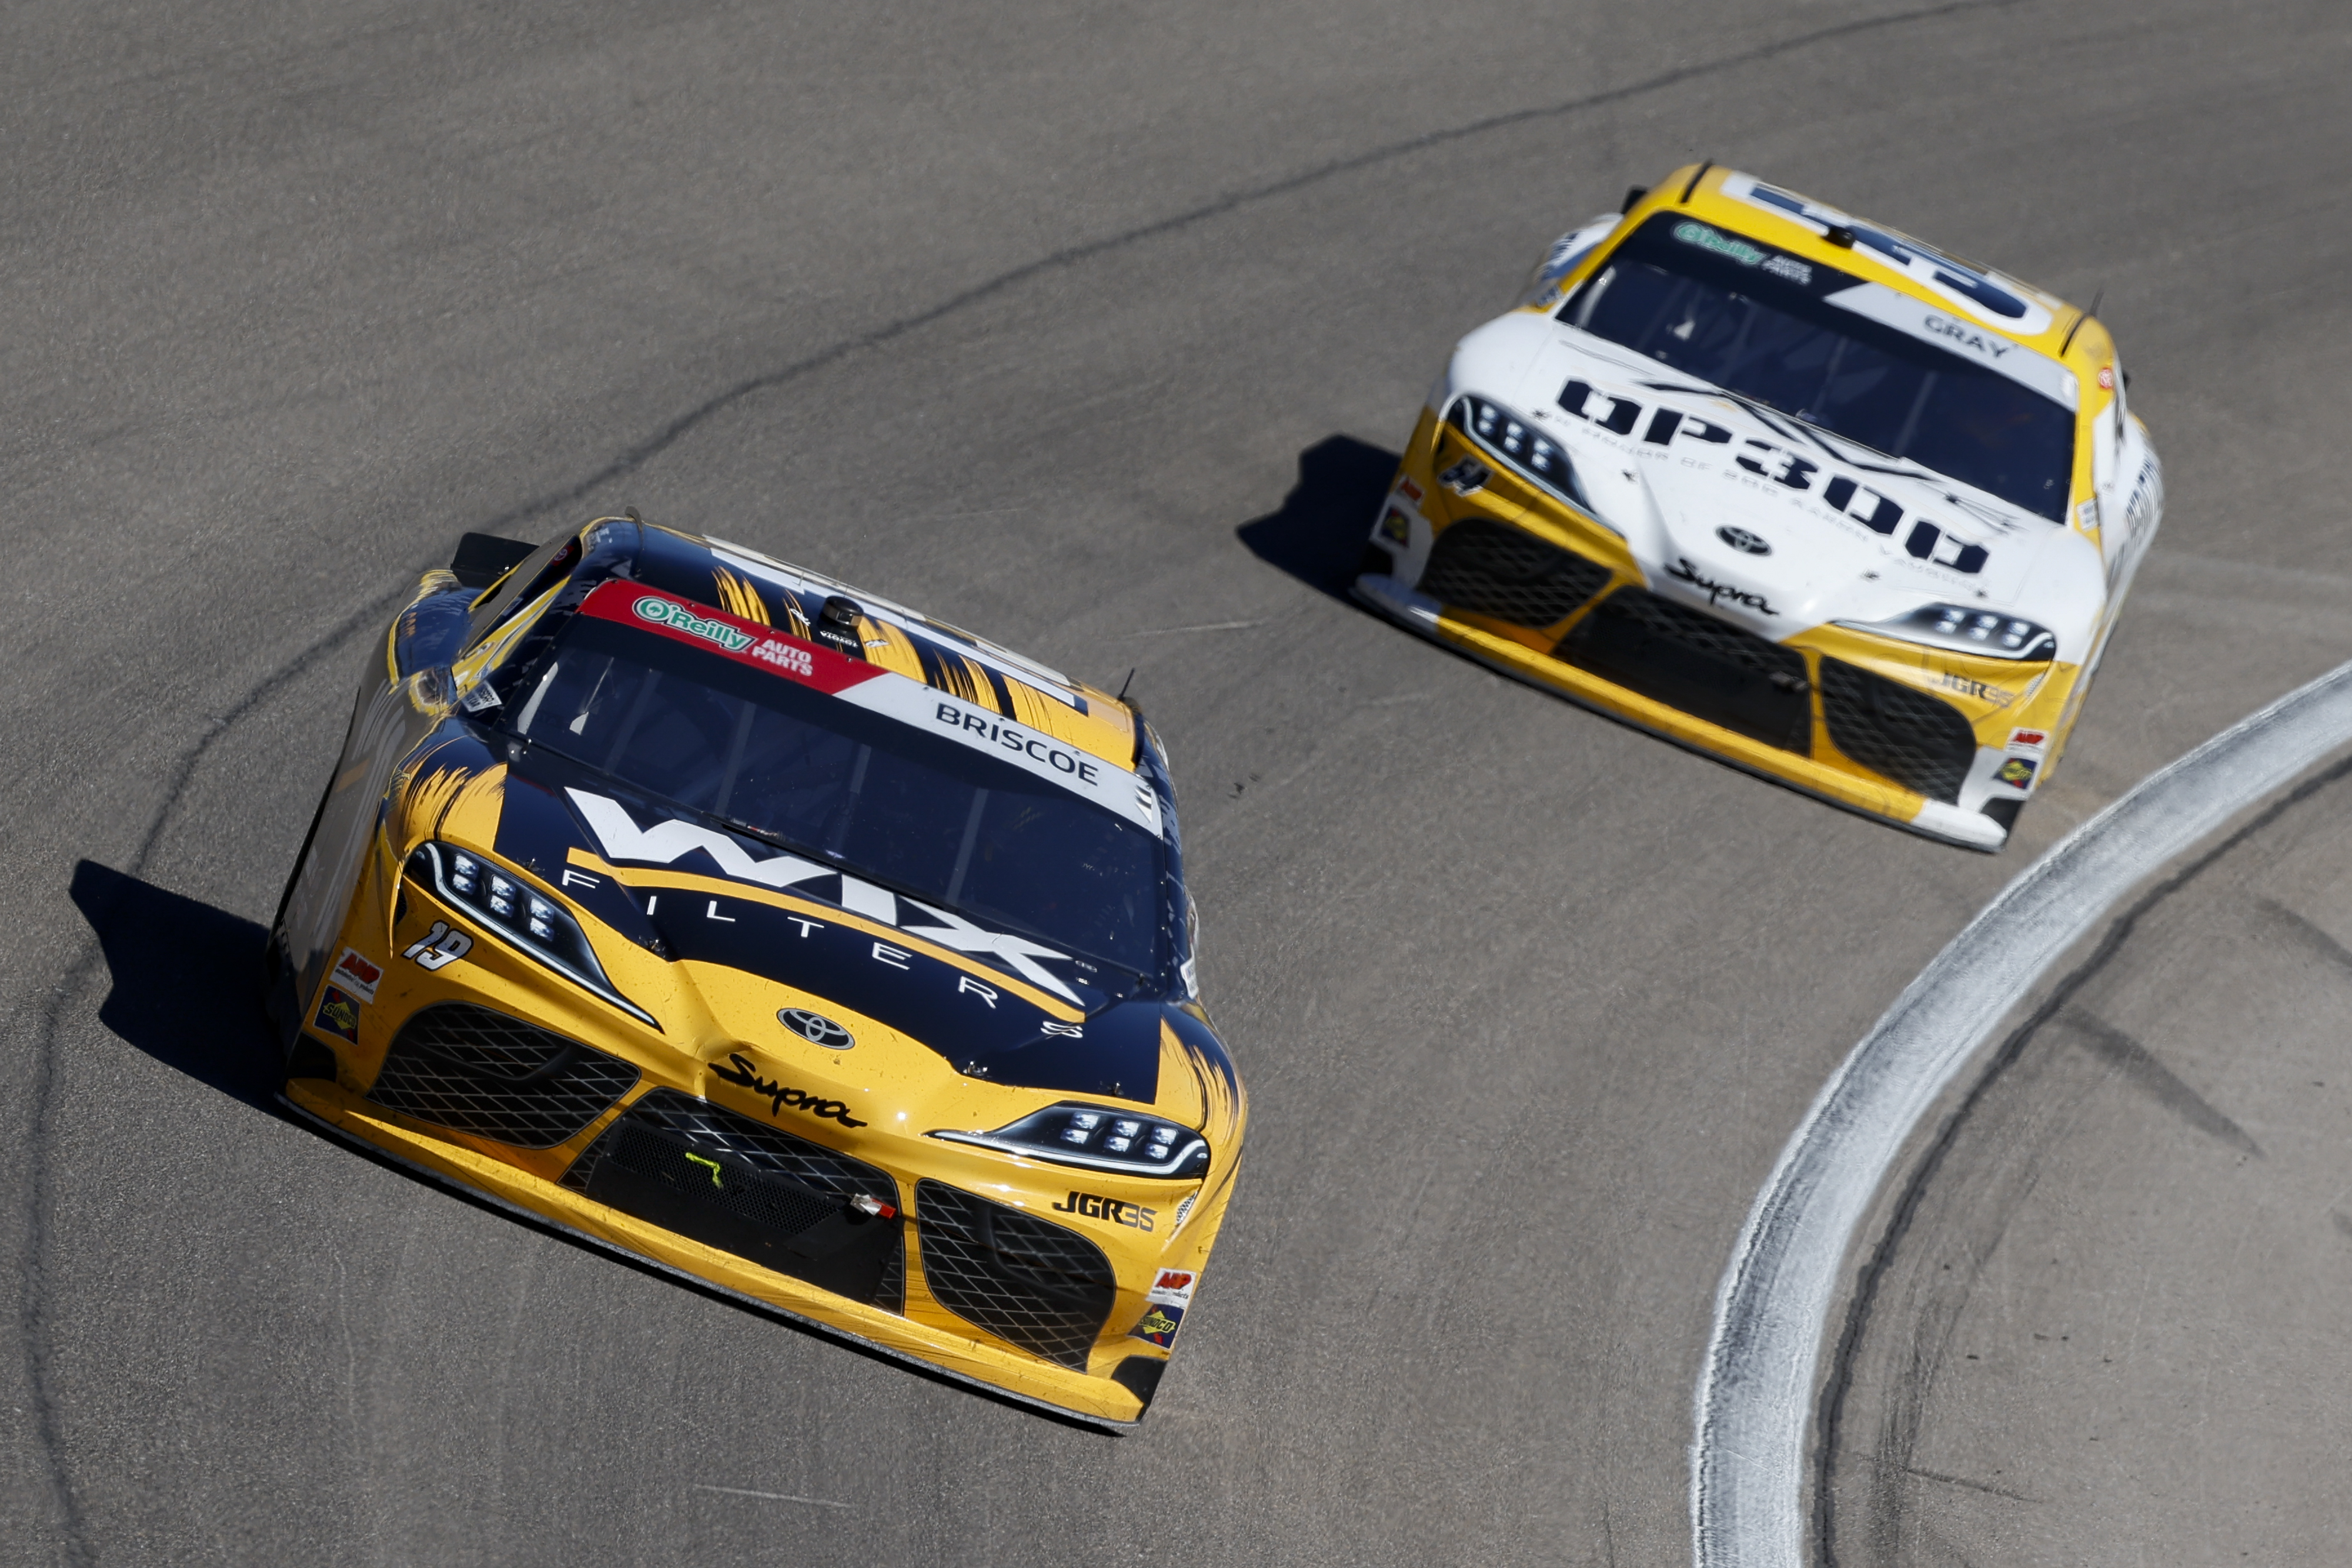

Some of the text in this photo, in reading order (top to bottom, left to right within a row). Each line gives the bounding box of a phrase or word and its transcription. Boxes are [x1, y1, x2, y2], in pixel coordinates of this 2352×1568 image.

[1925, 314, 2009, 359] GRAY
[1662, 558, 1780, 615] Supra
[637, 598, 751, 650] O'Reilly
[820, 630, 858, 647] TOYOTA
[752, 646, 813, 677] PARTS
[762, 639, 811, 663] AUTO
[936, 703, 1099, 786] BRISCOE
[564, 786, 1086, 1007] WIX
[401, 920, 474, 971] 19
[562, 870, 1084, 1038] FILTERS
[324, 1003, 356, 1028] SUNOCO
[707, 1054, 868, 1128] Supra
